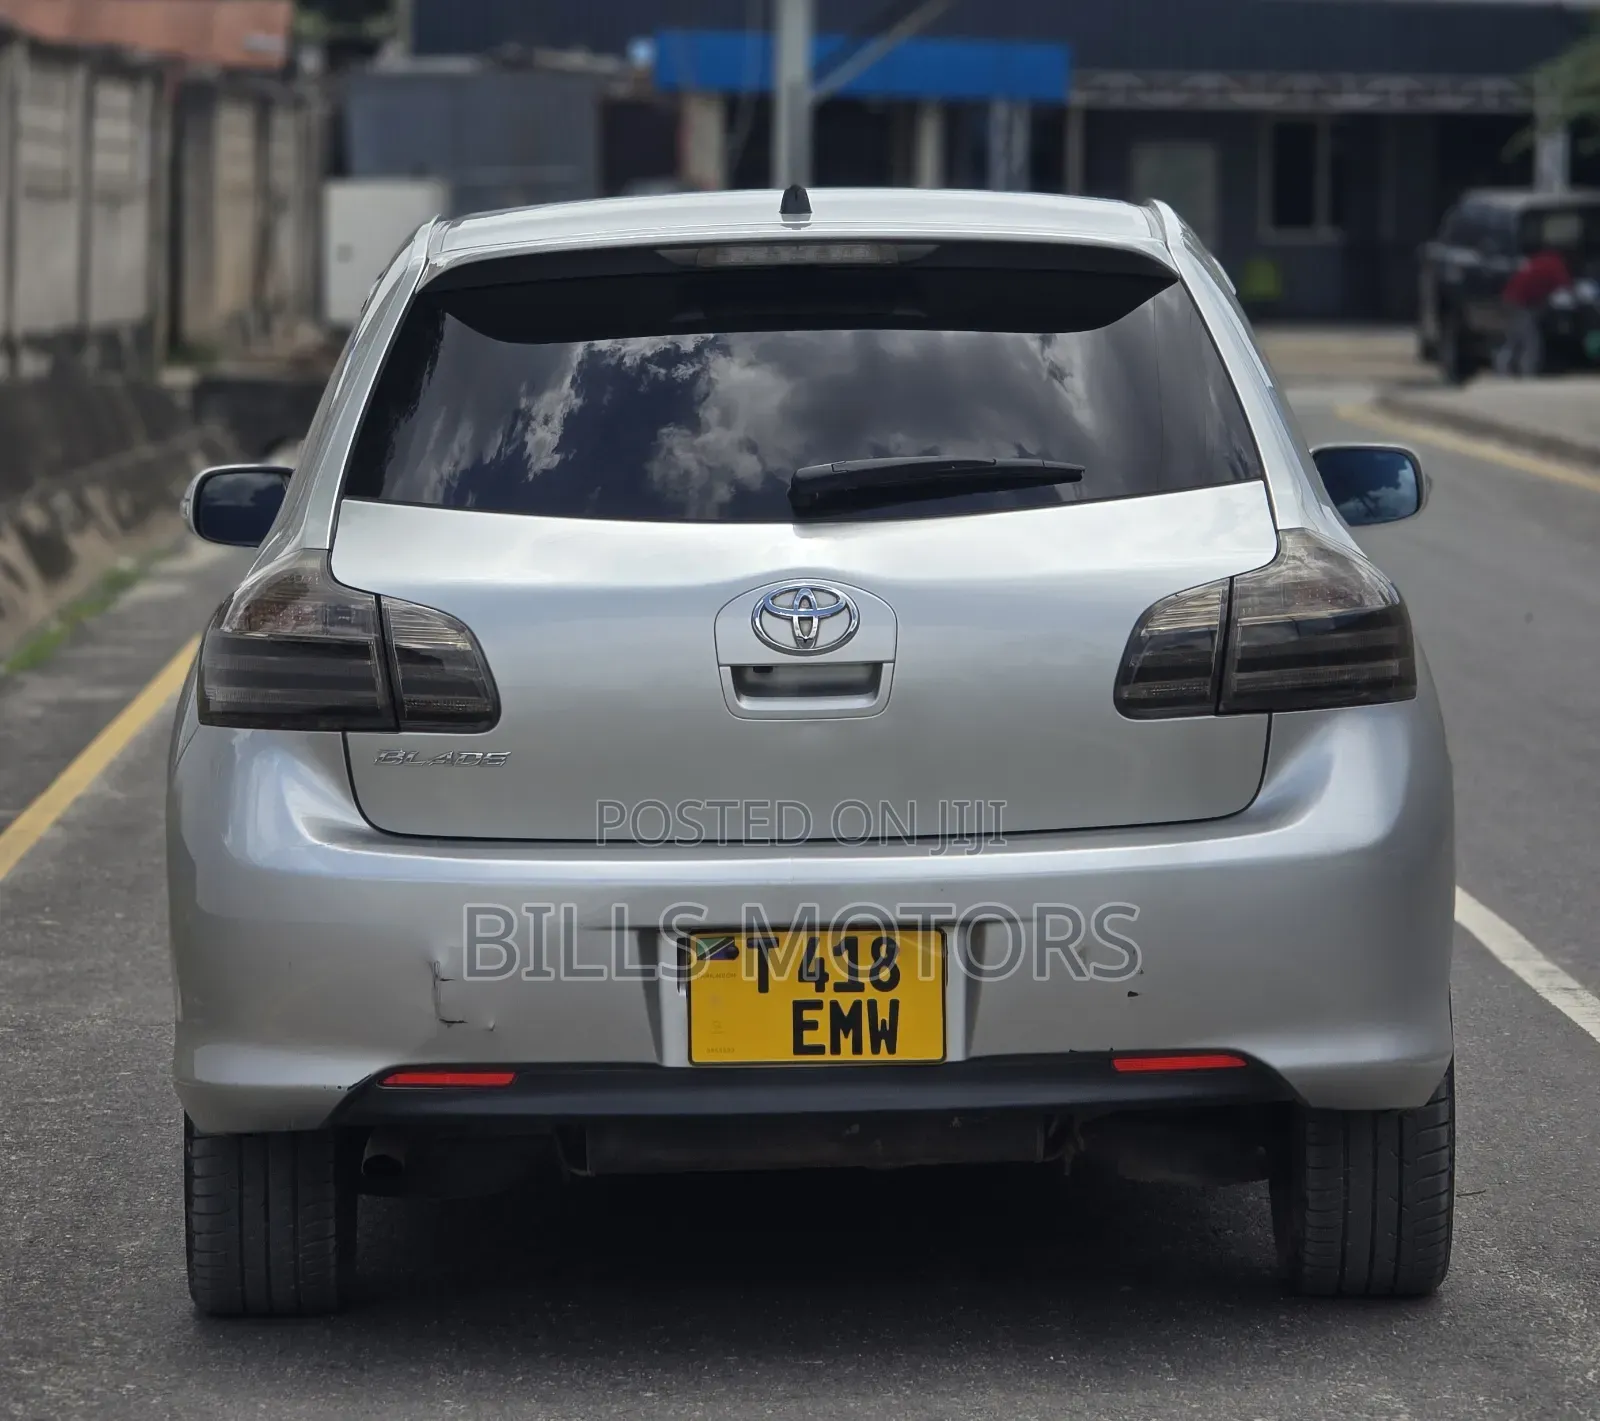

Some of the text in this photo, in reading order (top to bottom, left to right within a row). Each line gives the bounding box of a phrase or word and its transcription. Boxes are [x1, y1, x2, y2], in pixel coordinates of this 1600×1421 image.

[373, 748, 512, 767] BLADE
[747, 936, 901, 993] T 418
[792, 998, 900, 1056] EMW
